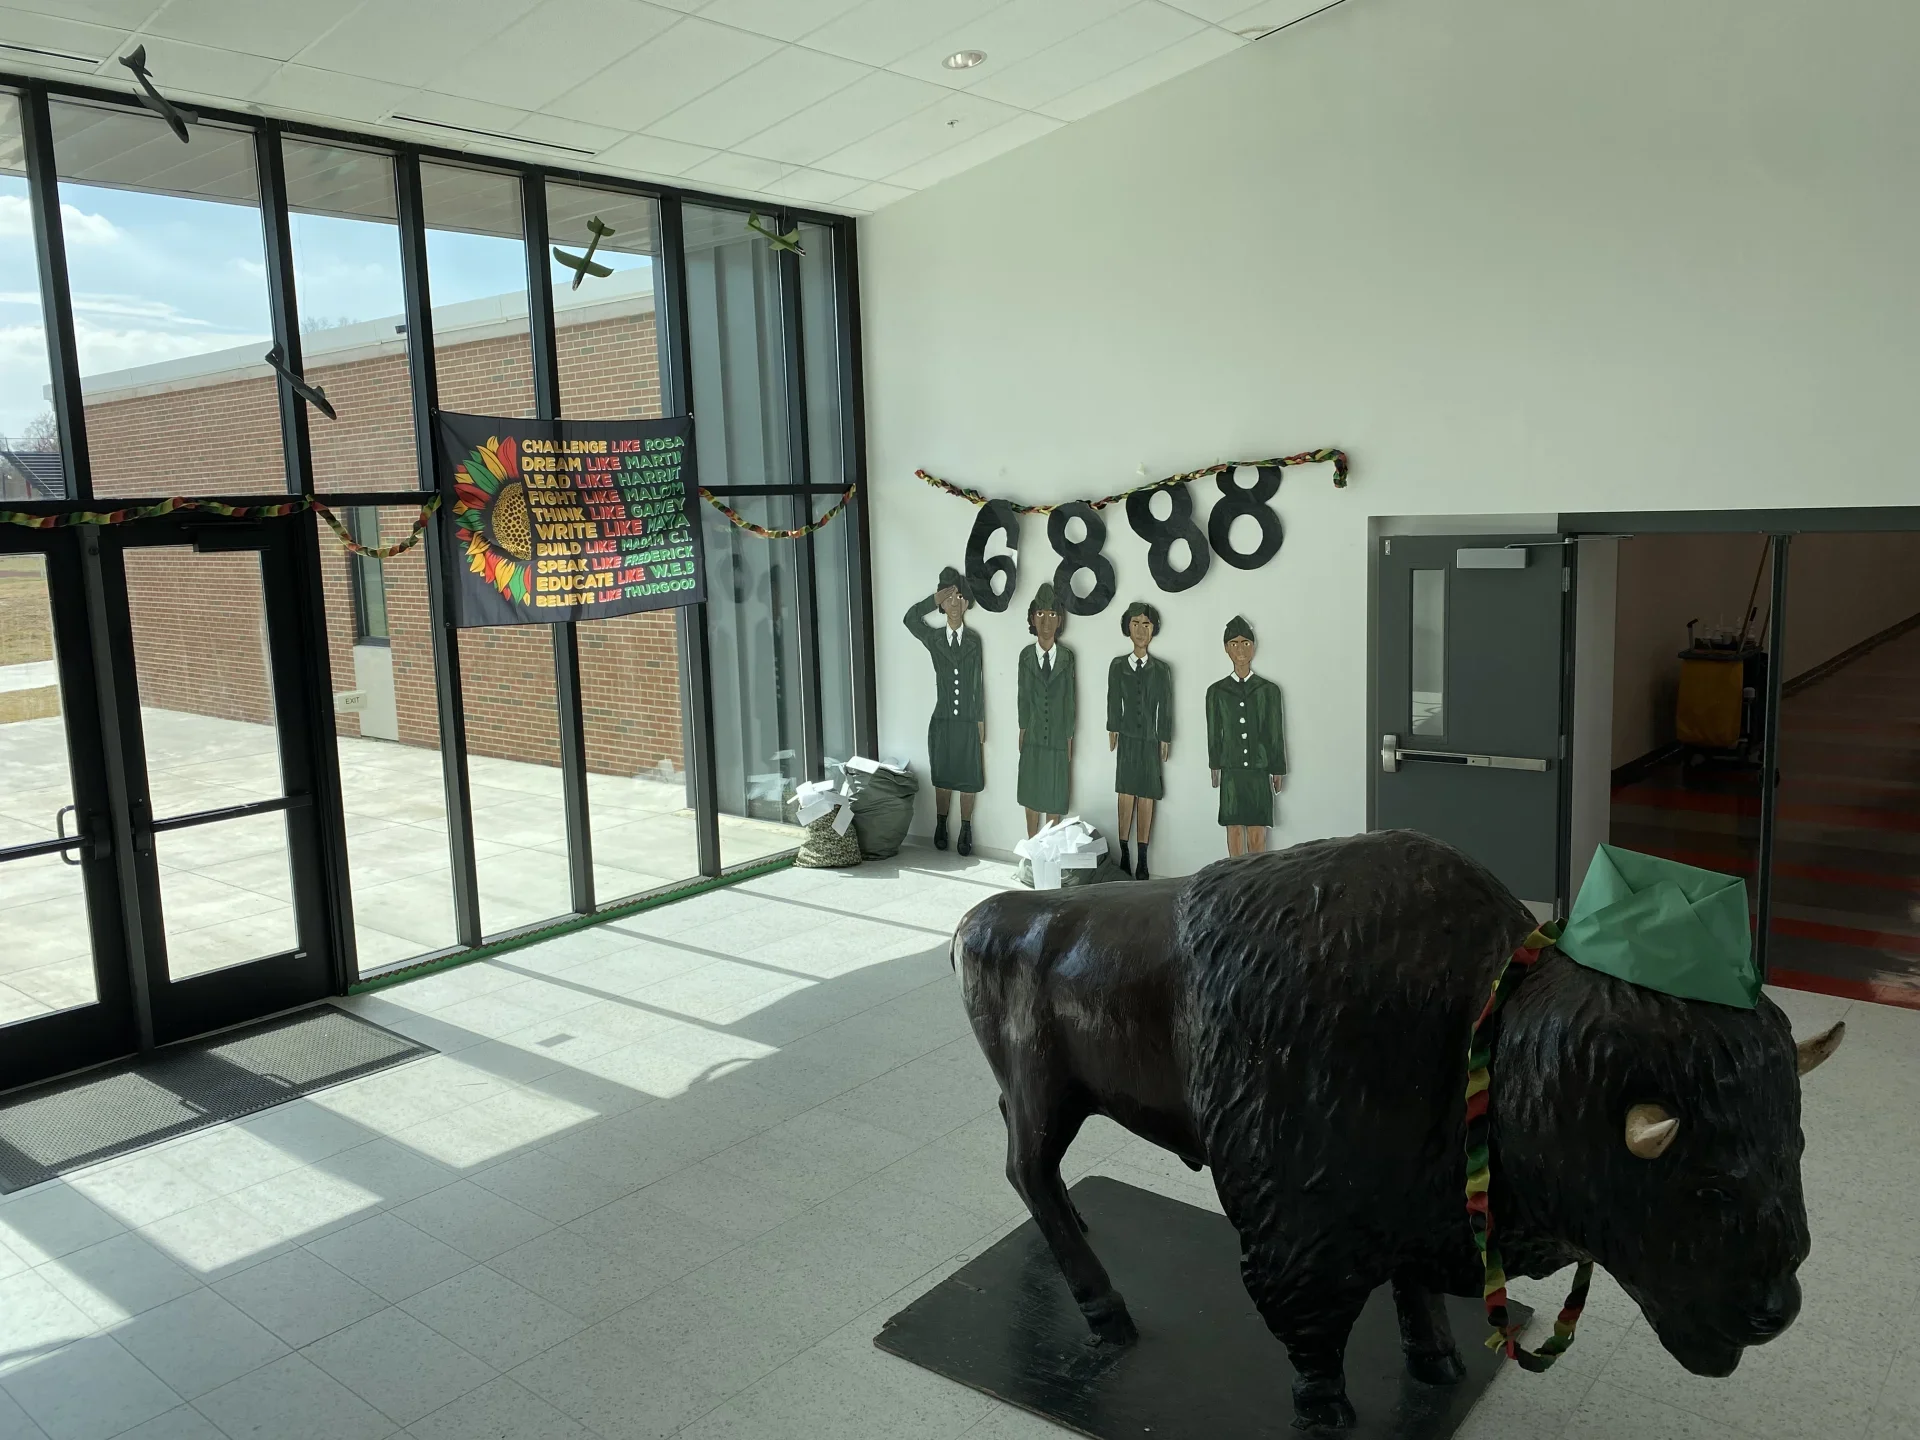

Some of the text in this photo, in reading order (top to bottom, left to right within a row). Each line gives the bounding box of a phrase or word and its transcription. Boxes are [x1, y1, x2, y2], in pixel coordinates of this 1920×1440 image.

[521, 436, 685, 454] CHALLENGE LIKE ROSA
[521, 456, 582, 472] DREAM
[585, 456, 622, 472] LIKE
[523, 473, 571, 489] LEAD
[575, 473, 614, 489] LIKE
[527, 490, 577, 506] FIGHT
[582, 489, 621, 505] LIKE
[531, 497, 686, 523] THINK LIKE GARVEY
[535, 513, 691, 541] WRITE LIKE MAYA
[536, 542, 582, 557] BUILD
[585, 540, 618, 554] LIKE
[621, 533, 665, 552] MADAM
[965, 463, 1284, 617] 6888
[537, 545, 694, 574] SPEAK LIKE FREDERICK
[536, 572, 614, 592] EDUCATE
[617, 567, 646, 585] LIKE
[535, 578, 696, 608] BELIEVE LIKE THURGOOD
[345, 696, 360, 705] EXIT
